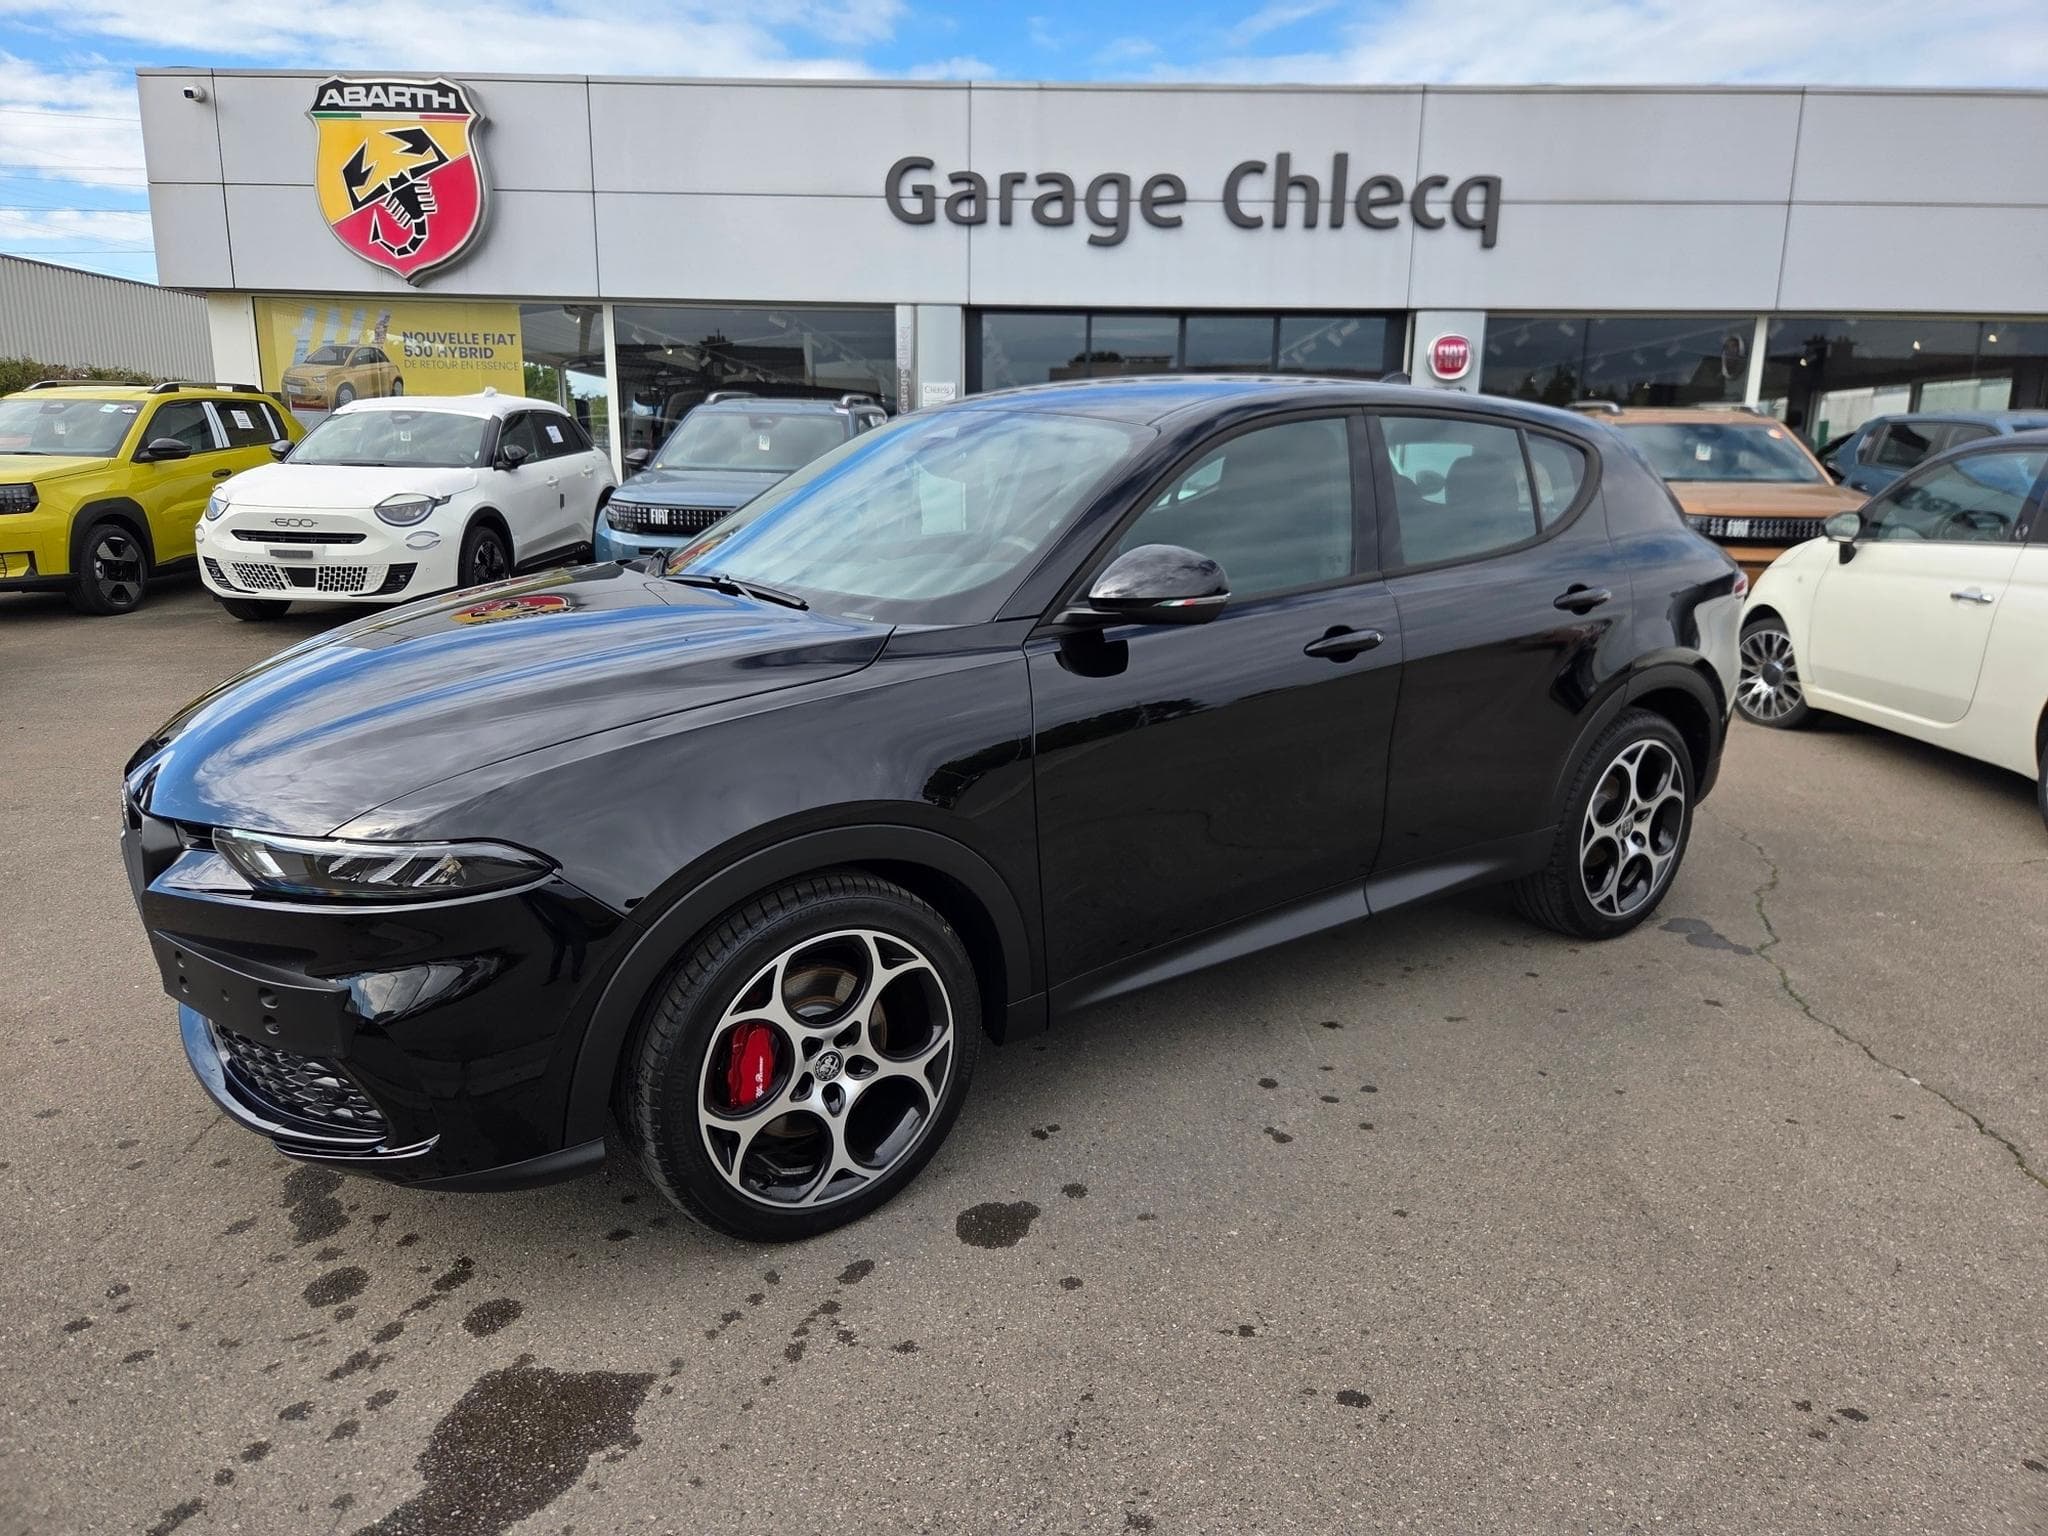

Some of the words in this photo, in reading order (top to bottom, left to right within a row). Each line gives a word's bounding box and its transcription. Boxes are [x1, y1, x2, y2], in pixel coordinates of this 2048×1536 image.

[320, 85, 456, 109] ABARTH
[885, 156, 1187, 247] Garage
[1222, 152, 1502, 248] Chlecq
[402, 331, 480, 345] NOUVELLE
[483, 332, 516, 346] FIAT
[403, 345, 433, 358] 500
[438, 346, 494, 360] HYBRID
[404, 359, 418, 369] DE
[419, 359, 458, 370] RETOUR
[461, 360, 474, 370] EN
[476, 361, 520, 372] ESSENCE
[275, 517, 314, 528] 600
[651, 508, 669, 525] FIAT
